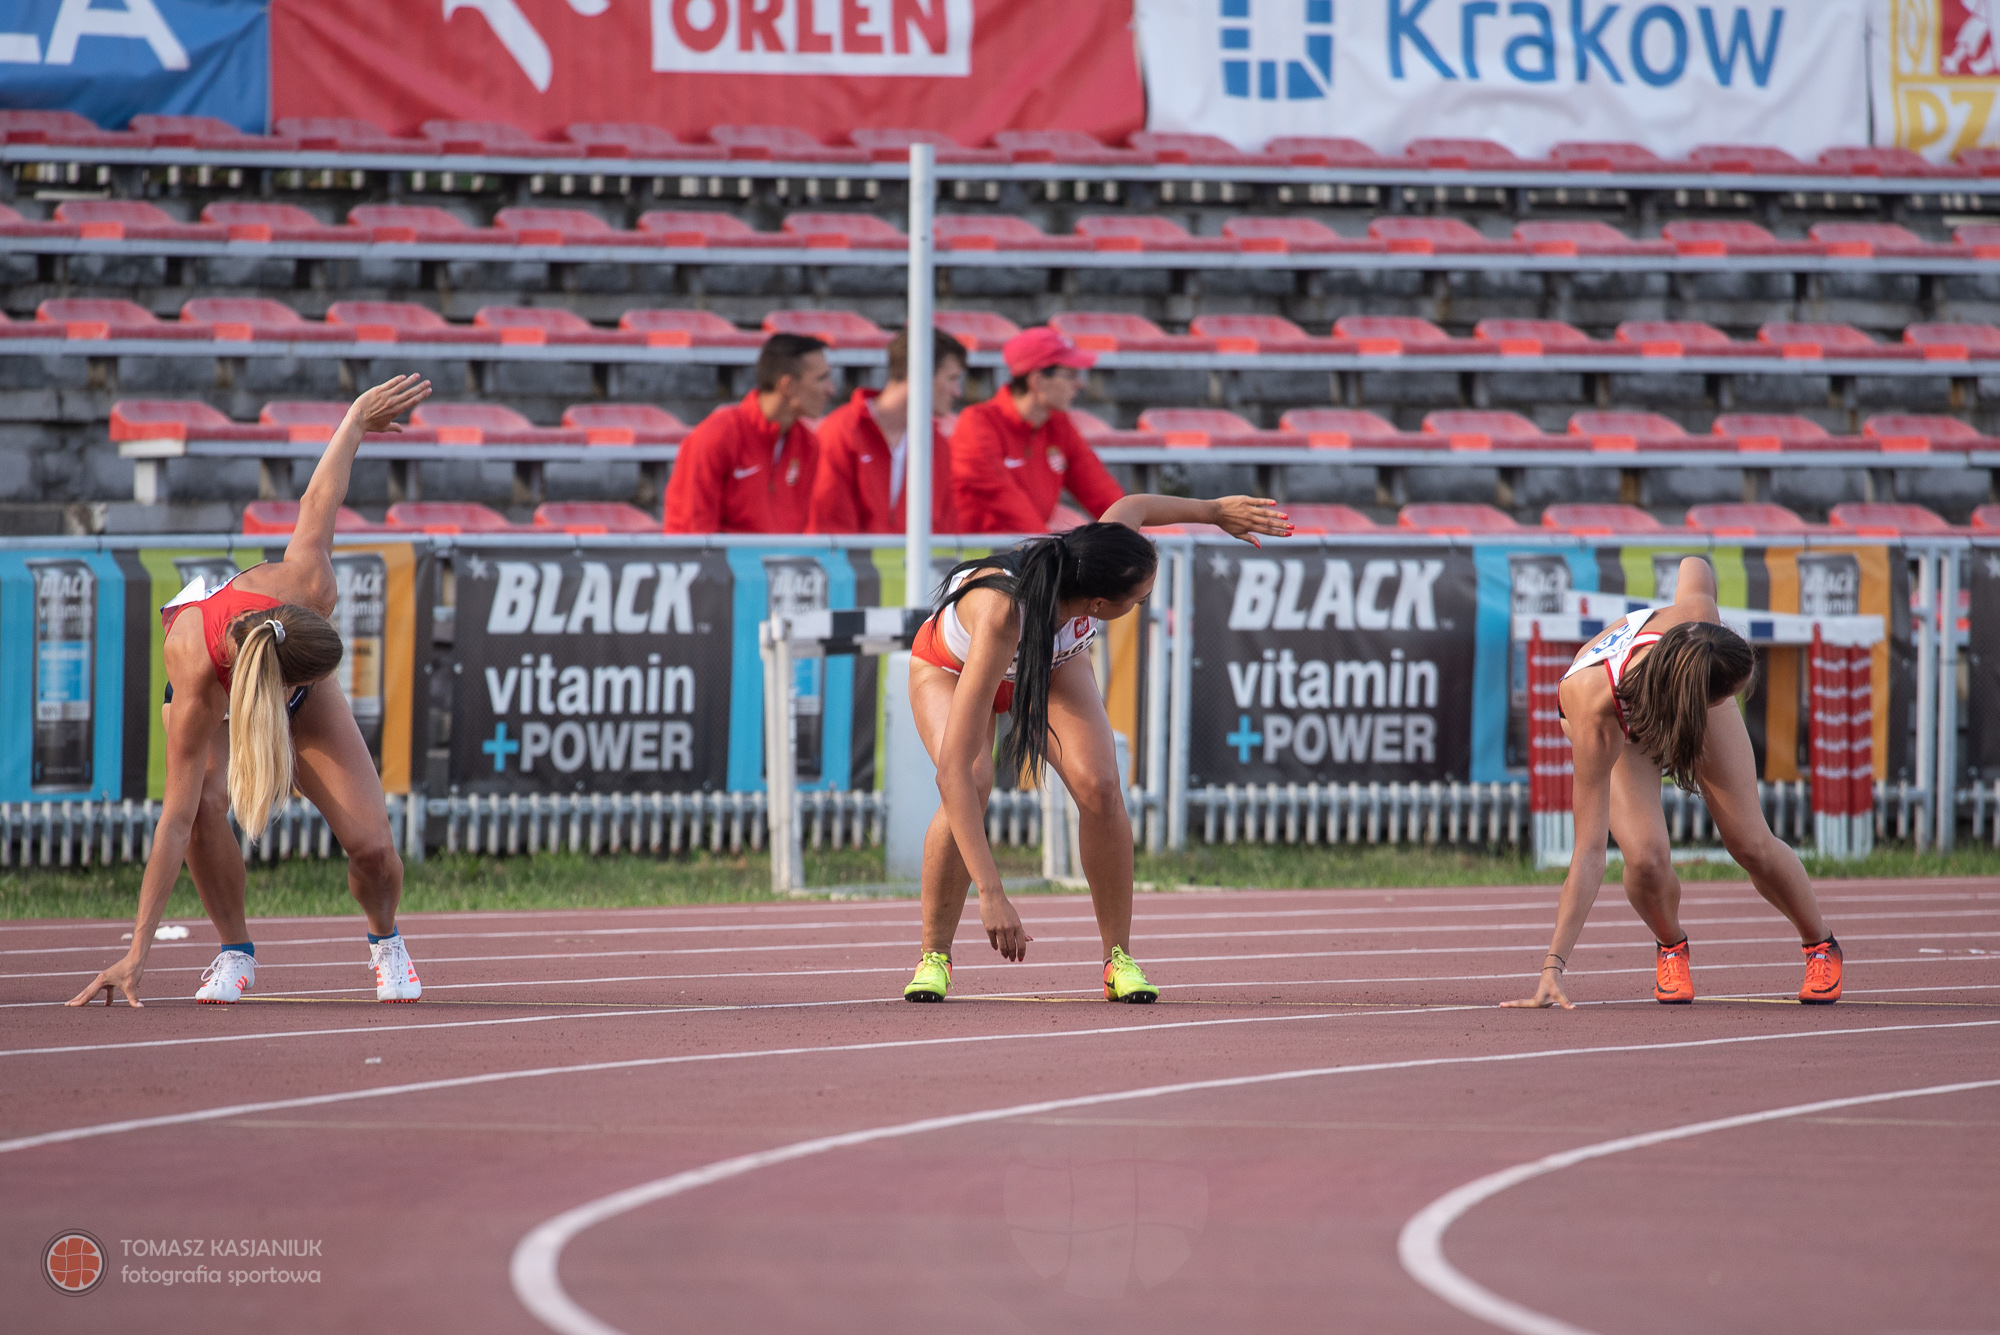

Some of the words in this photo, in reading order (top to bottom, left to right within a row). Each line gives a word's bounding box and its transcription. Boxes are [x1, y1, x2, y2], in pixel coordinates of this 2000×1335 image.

[671, 0, 946, 54] ORLEN
[487, 561, 700, 635] BLACK
[1228, 558, 1444, 631] BLACK
[485, 653, 696, 716] vitamin
[1227, 649, 1438, 709] vitamin
